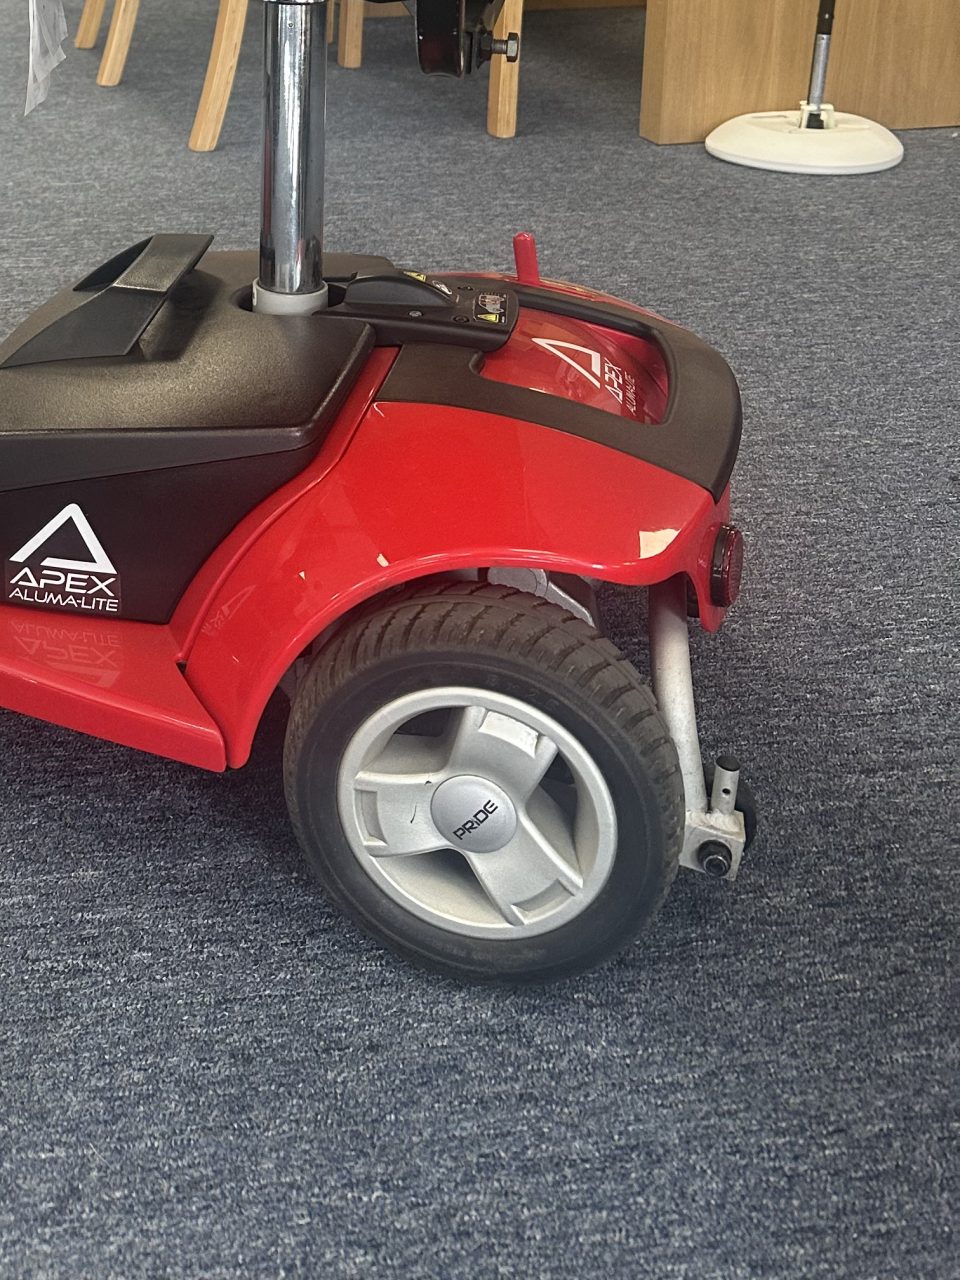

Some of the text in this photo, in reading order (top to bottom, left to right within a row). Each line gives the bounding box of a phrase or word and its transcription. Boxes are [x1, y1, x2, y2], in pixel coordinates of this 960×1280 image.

[604, 357, 622, 404] APEX
[8, 587, 119, 611] ALUMA-LITE
[9, 567, 116, 597] APEX
[452, 799, 499, 840] PRIDE
